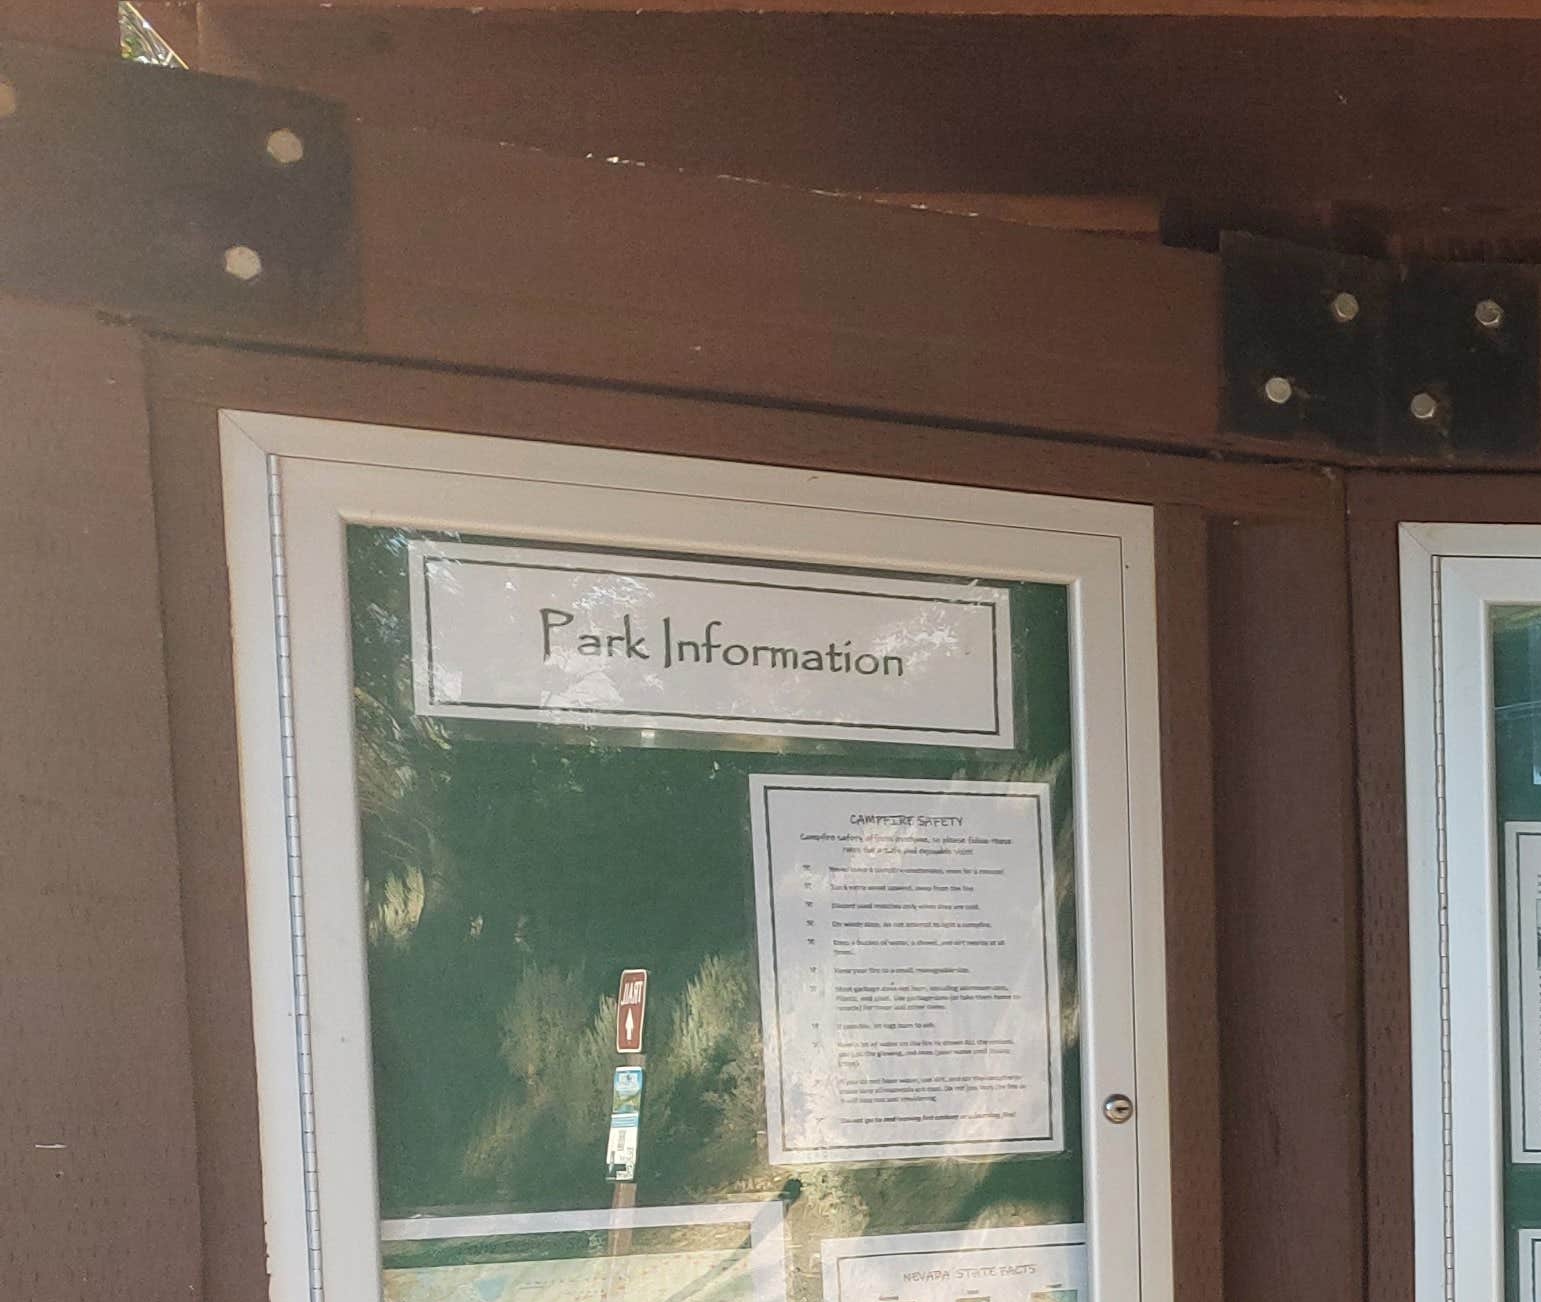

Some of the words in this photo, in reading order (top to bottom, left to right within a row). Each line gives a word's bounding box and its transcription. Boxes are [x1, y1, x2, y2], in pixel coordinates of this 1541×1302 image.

[541, 607, 650, 666] Park
[663, 615, 905, 677] Information
[850, 814, 913, 826] CAMPFIRE
[917, 816, 963, 827] SAFETY
[903, 1270, 950, 1282] NEVADA
[956, 1267, 995, 1279] STATE
[1000, 1264, 1037, 1277] FACTS
